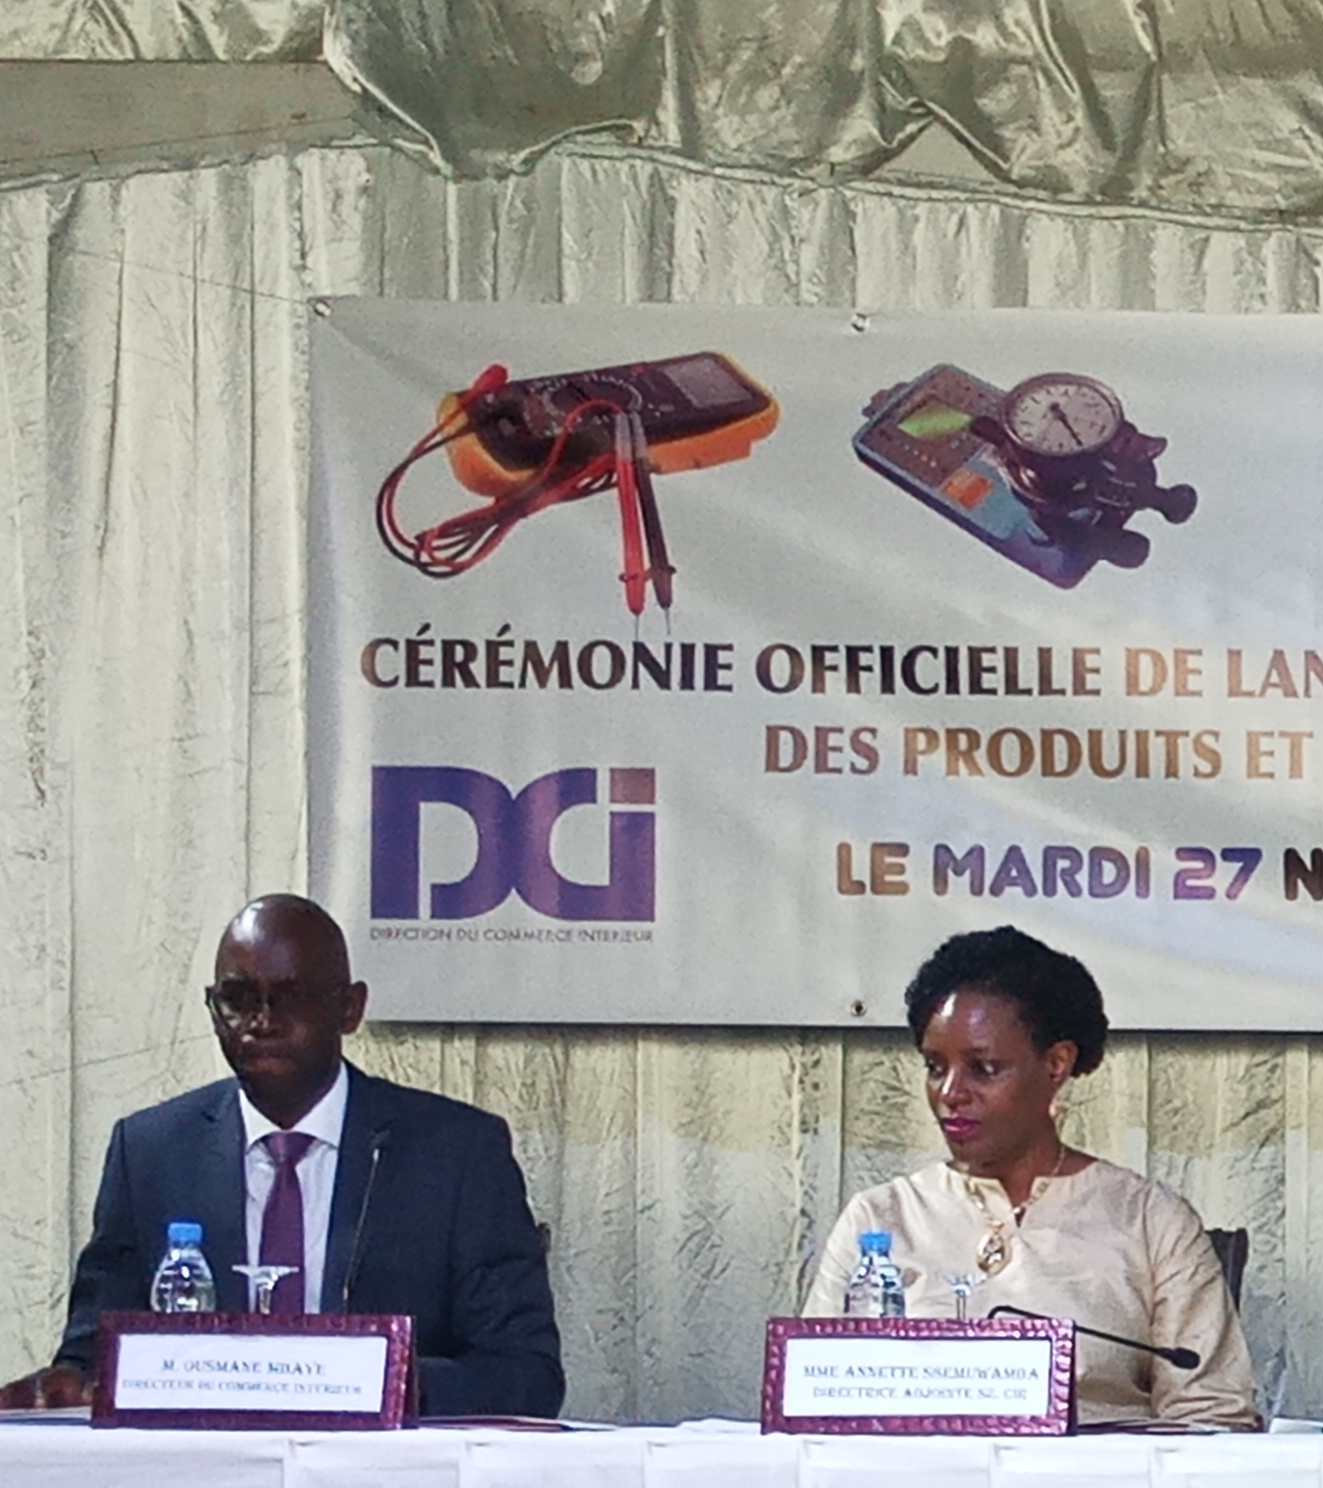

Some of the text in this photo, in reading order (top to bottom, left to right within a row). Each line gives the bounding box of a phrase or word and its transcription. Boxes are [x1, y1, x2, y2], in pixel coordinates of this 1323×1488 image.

[361, 624, 734, 692] CÉRÉMONIE
[757, 645, 1100, 696] OFFICIELLE
[1126, 649, 1203, 698] DE
[766, 726, 879, 776] DES
[905, 728, 1221, 780] PRODUITS
[1248, 732, 1314, 780] ET
[839, 843, 910, 896] LE
[934, 845, 1151, 899] MARDI
[1175, 848, 1263, 900] 27
[458, 929, 479, 942] DU
[484, 930, 573, 943] COMMERCE
